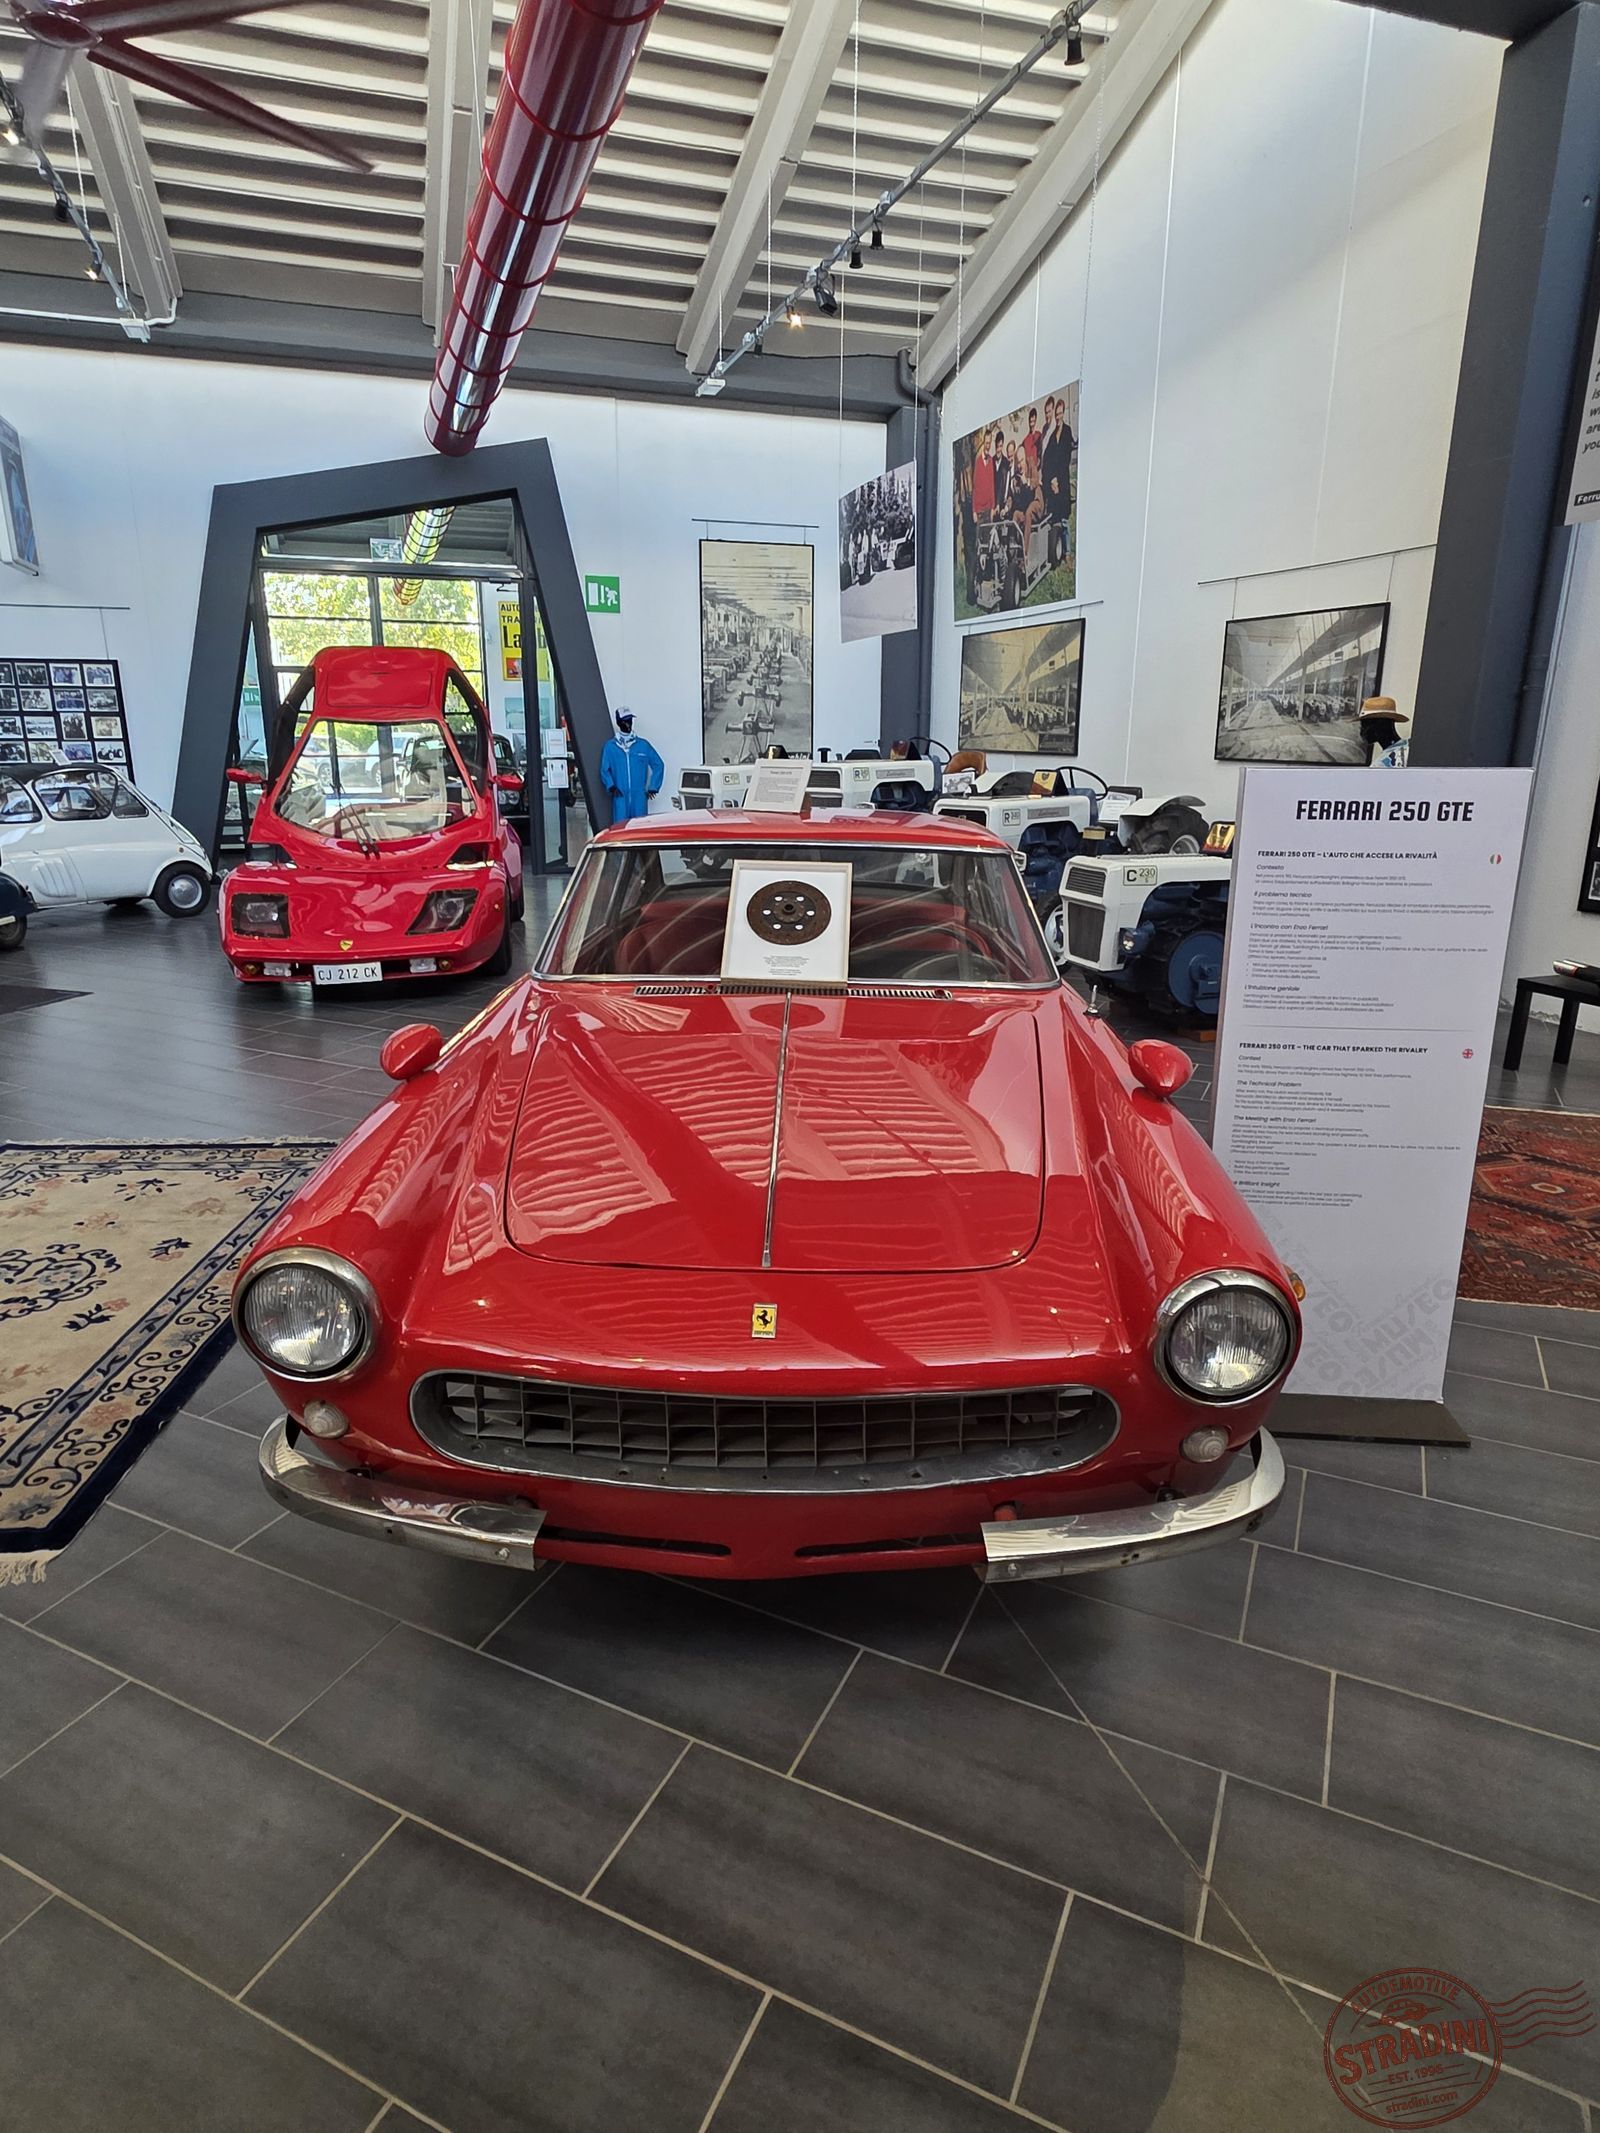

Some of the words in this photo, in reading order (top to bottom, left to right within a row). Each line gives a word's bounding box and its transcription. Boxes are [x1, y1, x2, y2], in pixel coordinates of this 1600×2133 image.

[1296, 800, 1382, 821] FERRARI
[1389, 801, 1430, 821] 250
[1437, 802, 1474, 822] GTE
[1127, 870, 1137, 882] C
[1139, 868, 1155, 876] 230
[318, 970, 332, 980] CJ
[338, 970, 358, 980] 212
[364, 966, 377, 978] CK
